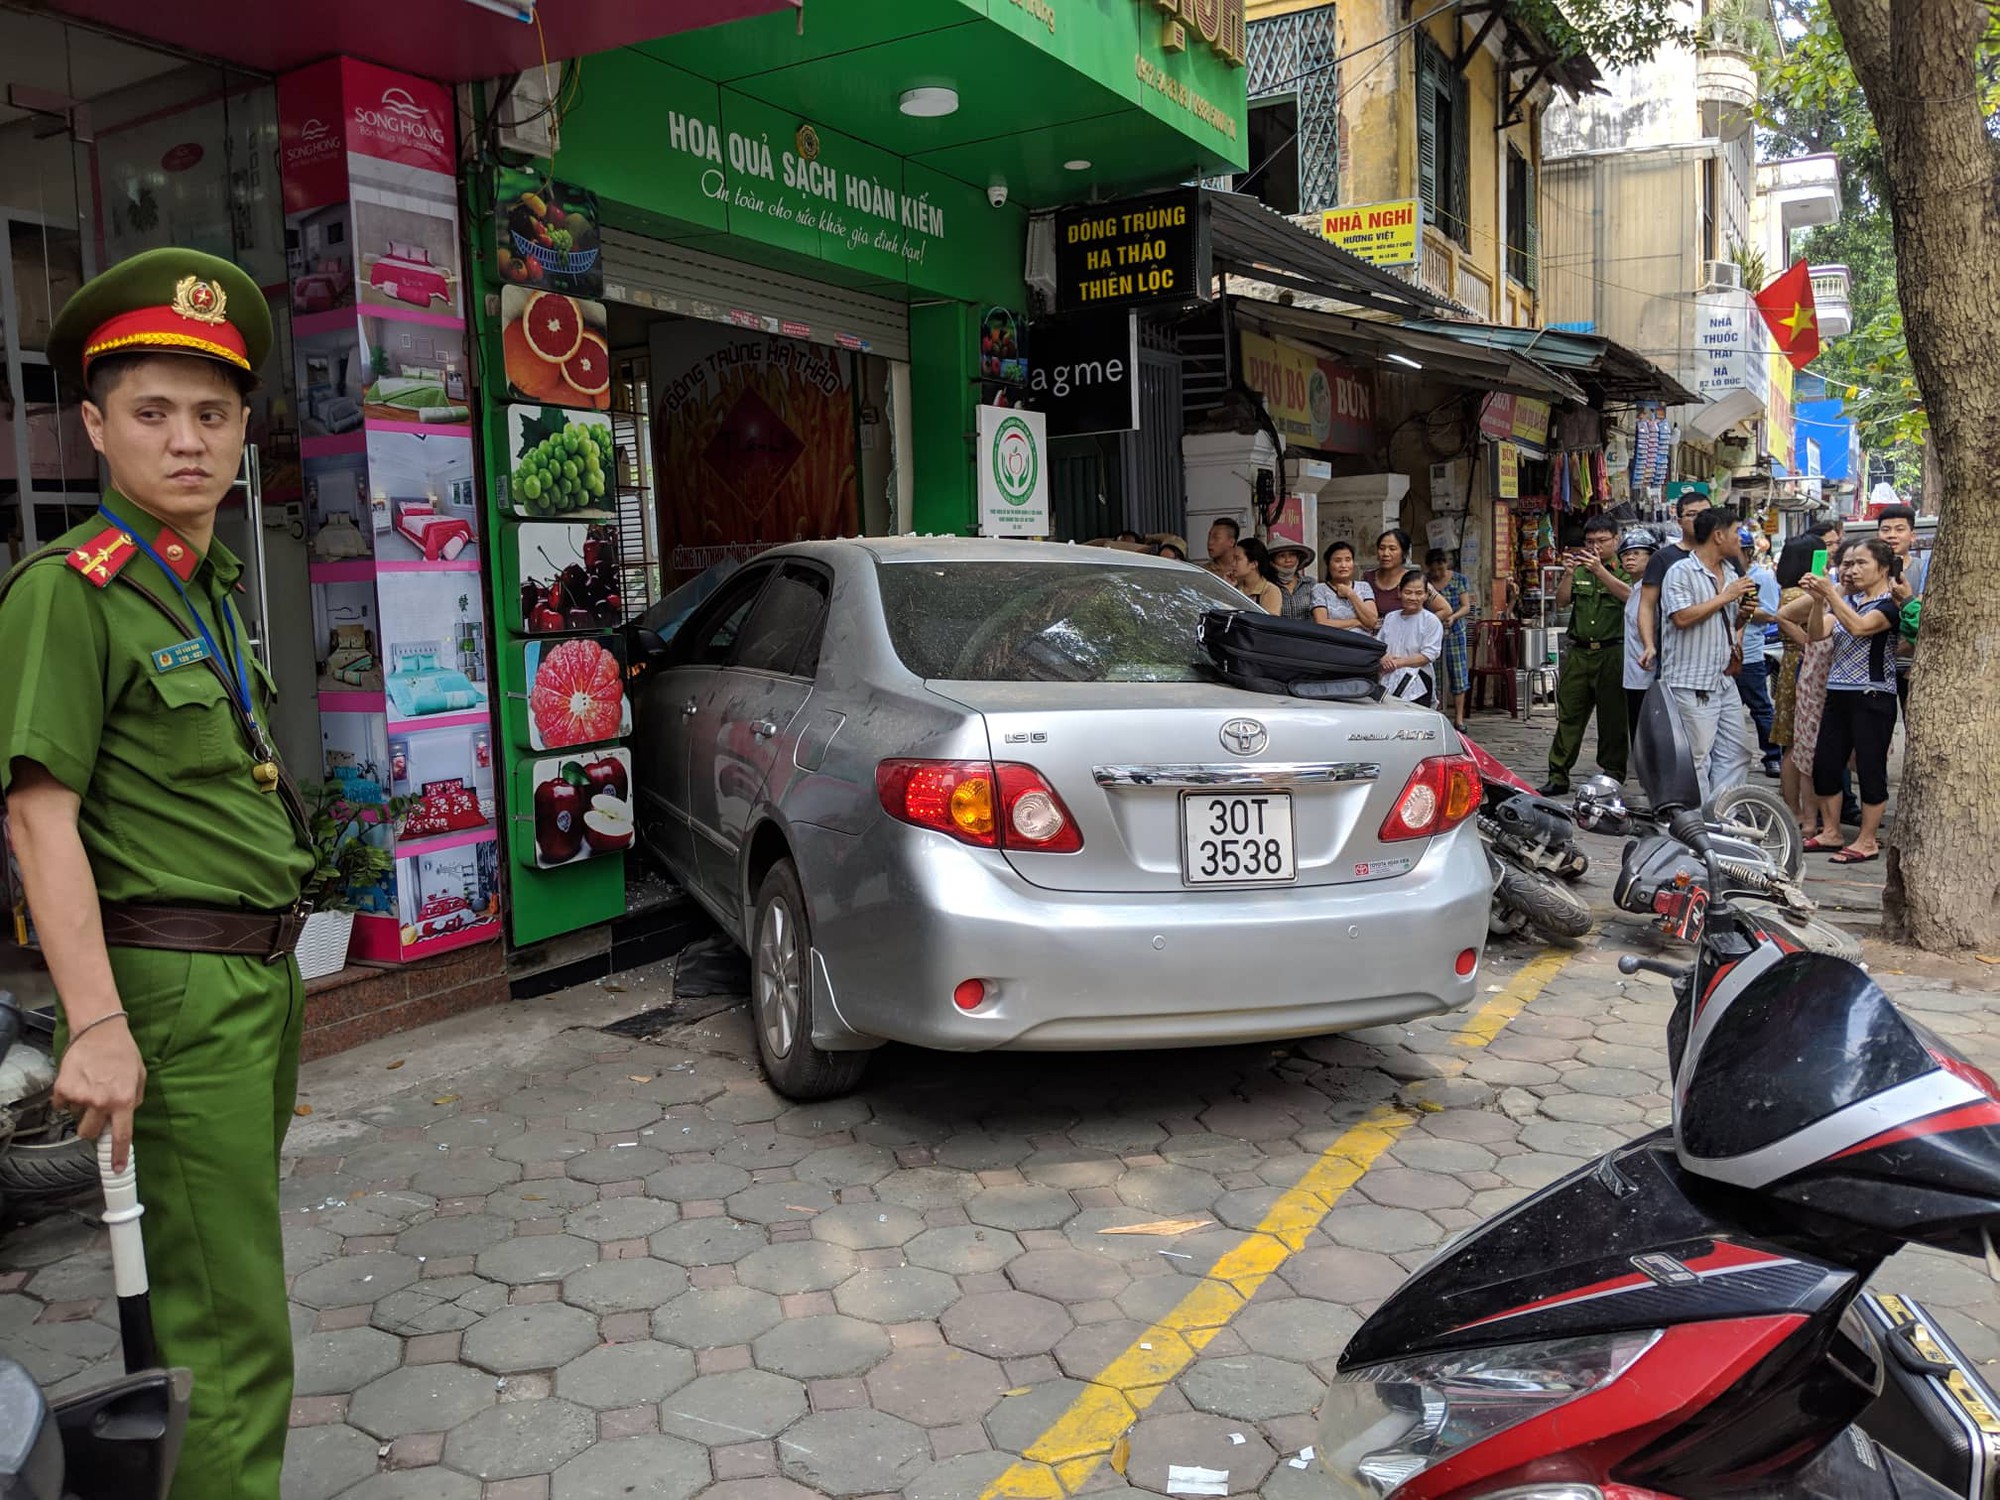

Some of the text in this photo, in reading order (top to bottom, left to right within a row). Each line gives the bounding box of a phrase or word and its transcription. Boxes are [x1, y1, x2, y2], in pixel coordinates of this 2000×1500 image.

[668, 110, 945, 239] HOA QUẢ SẠCH HOÀN KIẾM
[701, 168, 926, 266] An toàn cho sức khỏe gia đình bạn!
[1067, 216, 1118, 244] ĐÔNG
[1326, 203, 1413, 233] NHÀ NGHỈ
[1117, 233, 1167, 266] THẢO
[1376, 231, 1395, 241] VIỆT
[1078, 264, 1174, 301] THIÊN LỘC
[706, 340, 762, 373] TRÙNG
[1335, 374, 1370, 421] BÚN
[1208, 798, 1269, 836] 30T
[1200, 838, 1282, 877] 3538
